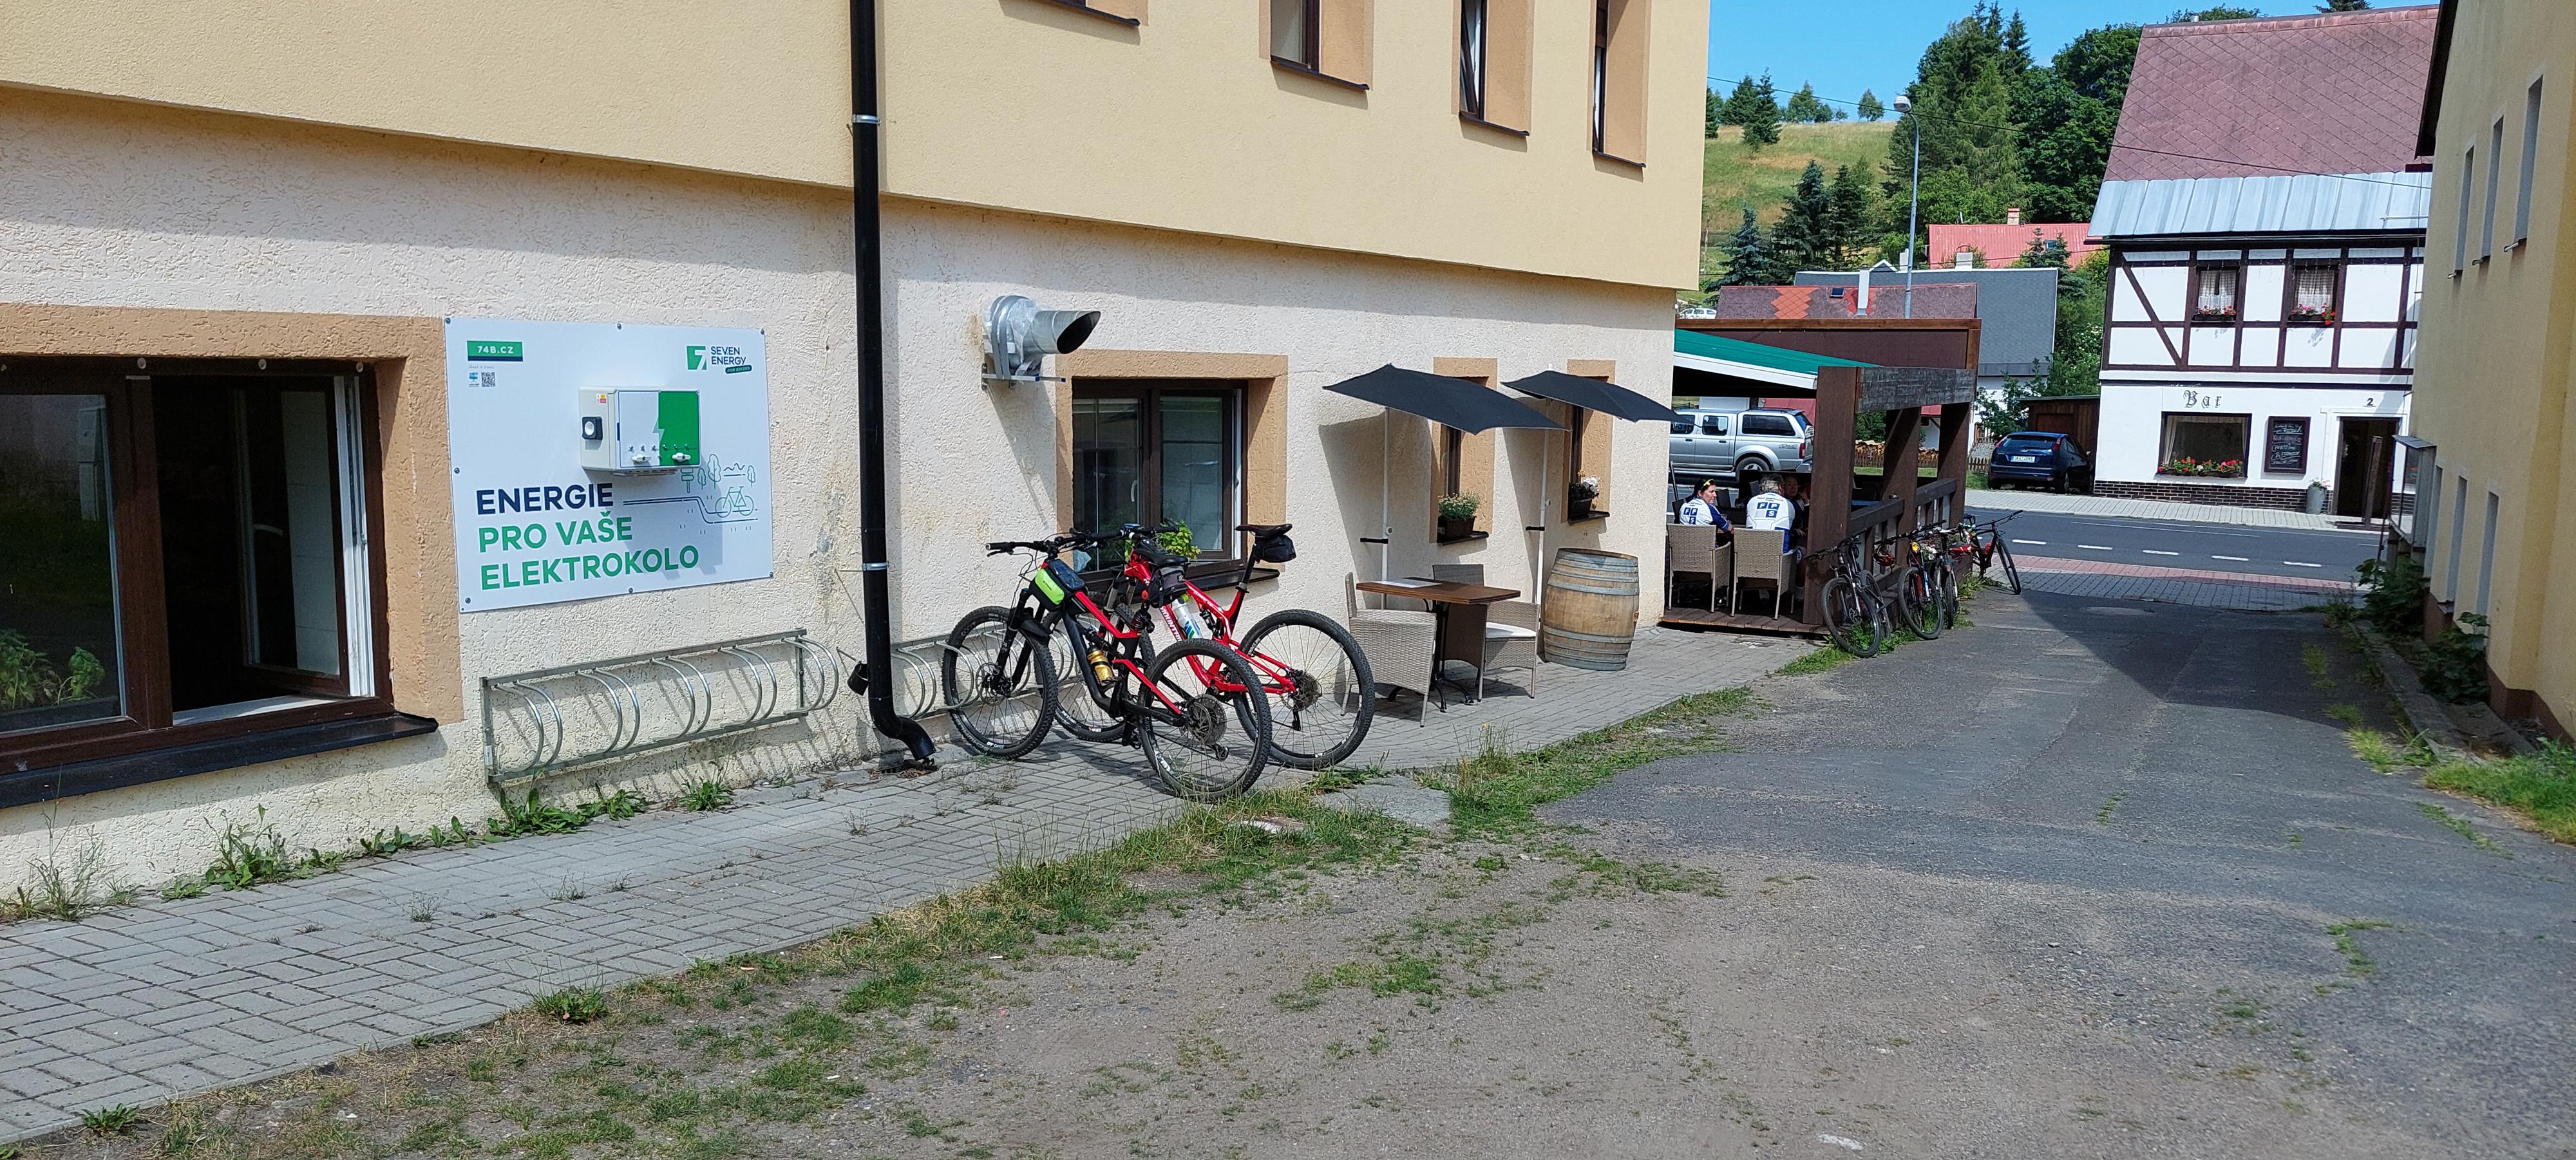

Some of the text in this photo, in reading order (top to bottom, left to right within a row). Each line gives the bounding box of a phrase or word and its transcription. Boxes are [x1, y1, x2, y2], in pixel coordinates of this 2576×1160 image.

[477, 345, 514, 354] 74B.CZ
[711, 356, 746, 366] ENERGY
[2183, 389, 2222, 409] Bar
[2367, 397, 2374, 406] 2
[476, 482, 614, 516] ENERGIE
[478, 510, 633, 553] PRO VAŠE
[480, 545, 699, 590] ELEKTROKOLO
